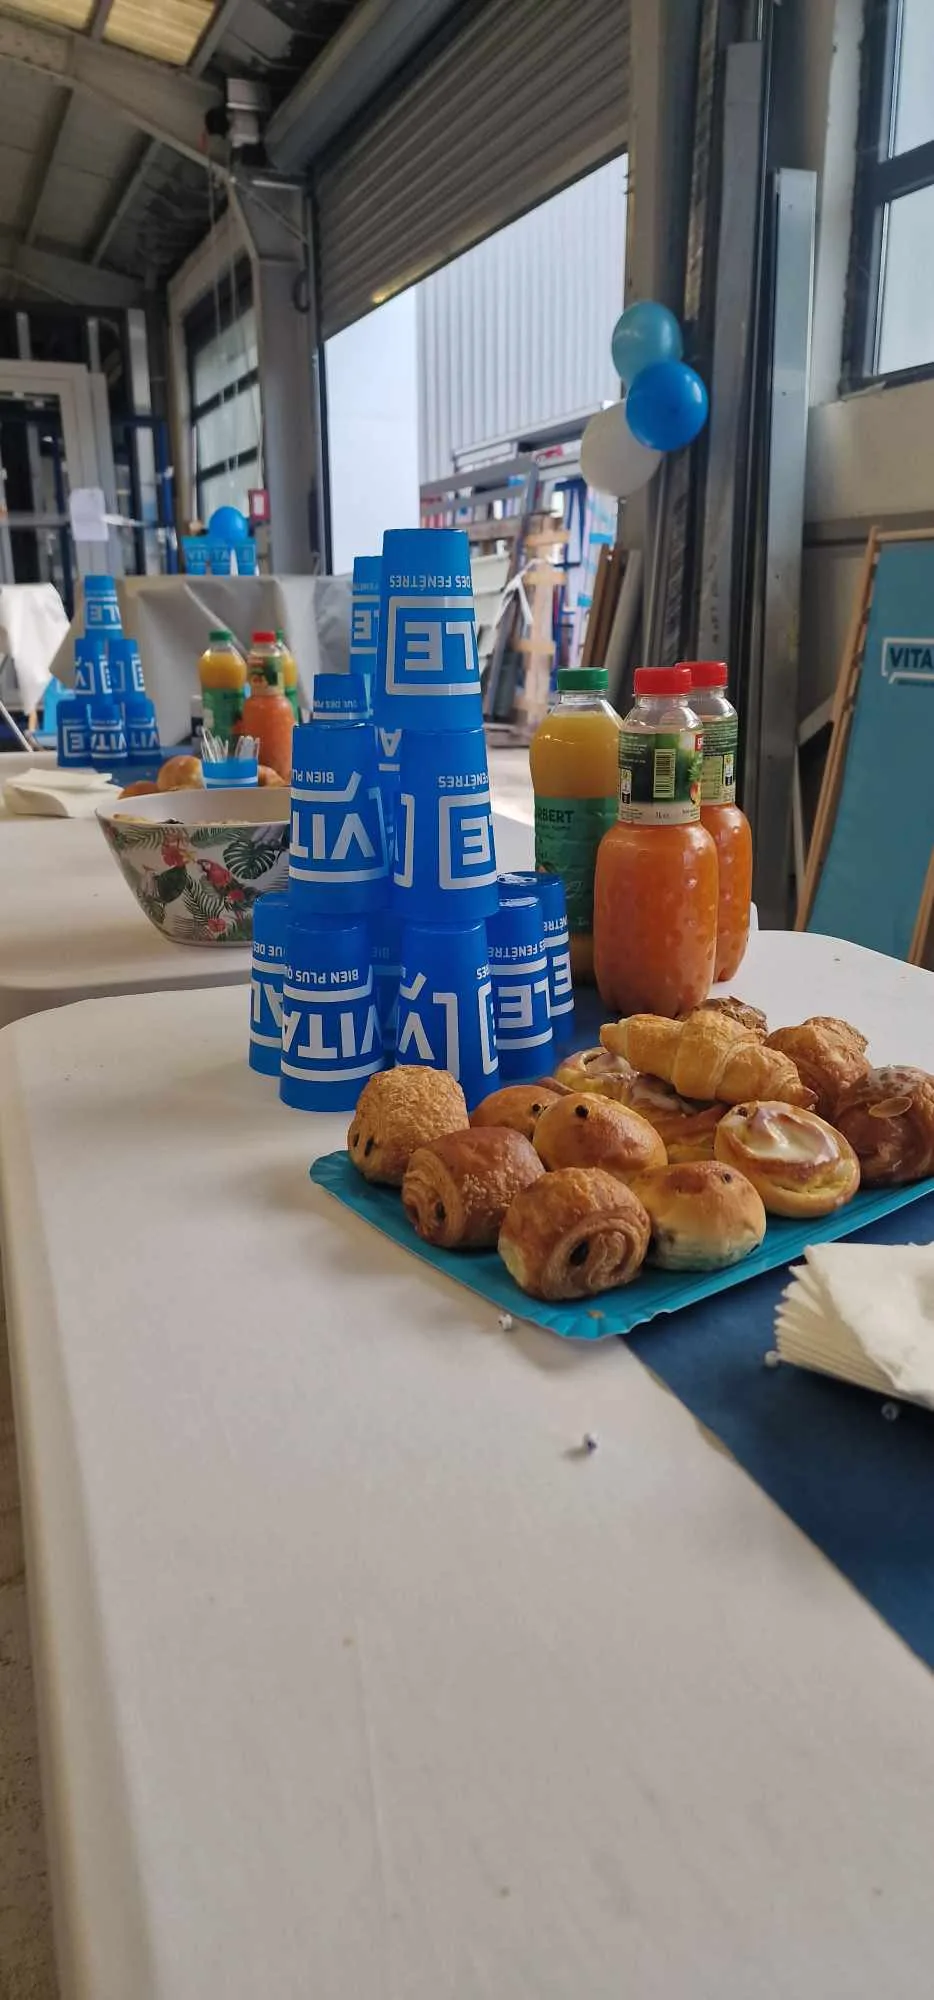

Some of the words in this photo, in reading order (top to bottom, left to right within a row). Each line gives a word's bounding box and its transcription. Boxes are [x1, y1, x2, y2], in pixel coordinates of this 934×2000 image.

[306, 771, 334, 784] BIEN
[295, 970, 326, 984] PLUS
[331, 968, 359, 983] BIEN
